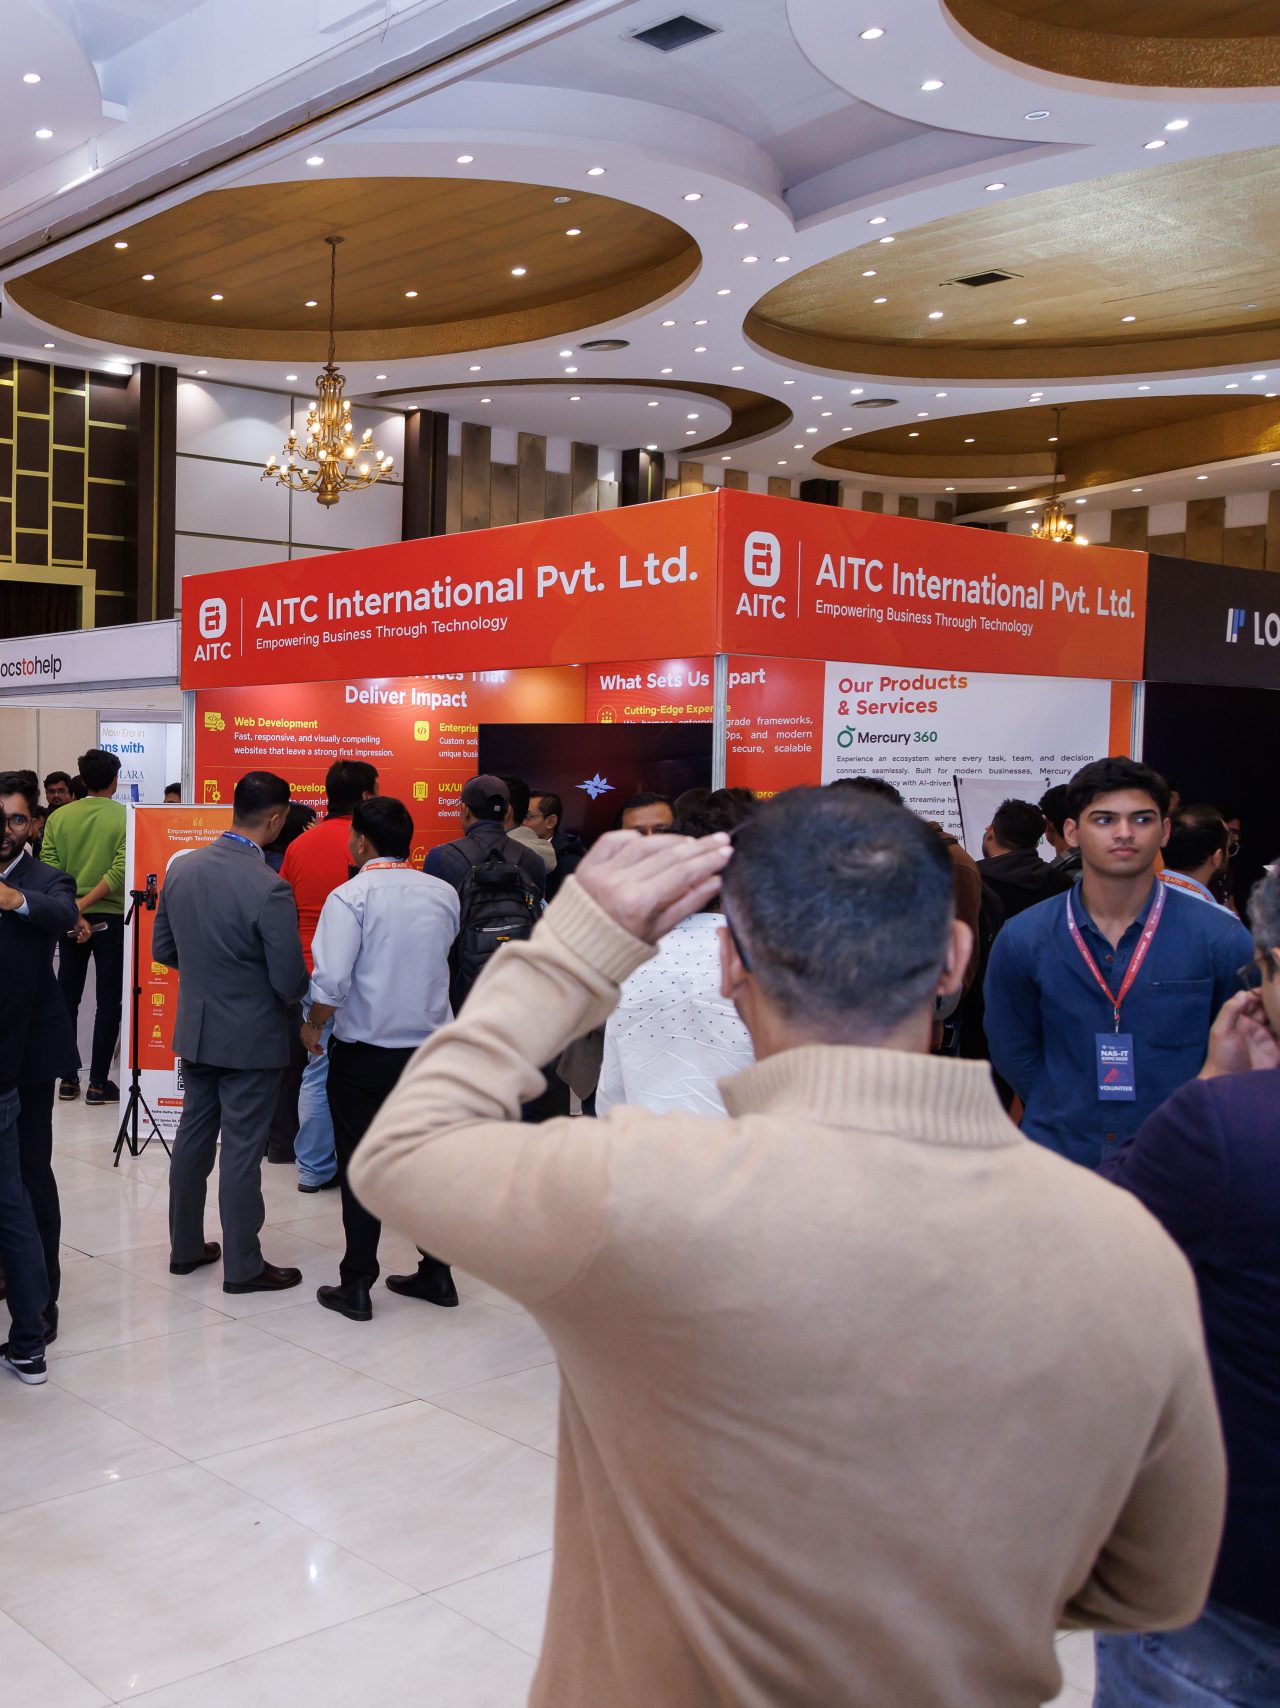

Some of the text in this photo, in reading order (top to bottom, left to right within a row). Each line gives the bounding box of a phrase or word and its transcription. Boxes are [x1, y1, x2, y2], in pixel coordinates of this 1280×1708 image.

[256, 546, 698, 628] AITC International Pvt. Ltd.
[815, 554, 1135, 618] AITC International Pvt. Ltd.
[736, 593, 786, 619] AITC
[815, 600, 1033, 636] Empowering Business Through Technology
[256, 616, 508, 650] Empowering Business Through Technology
[194, 642, 231, 661] AITC
[600, 668, 766, 690] What Sets Us part
[838, 674, 968, 693] Our Products
[345, 685, 467, 710] Deliver Impact
[624, 704, 684, 716] Cutting-Edge
[837, 697, 938, 716] & Services
[234, 716, 318, 730] Web Development
[757, 716, 813, 726] frameworks,
[234, 732, 381, 745] Fast, responsive, and visually compelling
[439, 736, 465, 745] Custom
[751, 730, 768, 739] and
[776, 730, 813, 739] modern
[857, 731, 938, 746] Mercury 360
[121, 741, 145, 753] with
[234, 745, 268, 755] websites
[269, 746, 285, 755] that
[286, 747, 306, 756] leave
[314, 748, 338, 758] strong
[339, 747, 353, 757] first
[355, 748, 394, 758] impression.
[732, 743, 812, 754] secure, scalable
[438, 749, 462, 759] unique
[836, 755, 874, 763] Experience
[1060, 754, 1094, 762] decision
[872, 767, 910, 775] seamlessly.
[989, 767, 1033, 775] businesses,
[1039, 767, 1072, 776] Mercury
[289, 782, 327, 795] Develop
[299, 798, 328, 807] complet
[438, 796, 462, 806] Engagi
[167, 828, 203, 836] Empowering
[168, 835, 193, 843] Through
